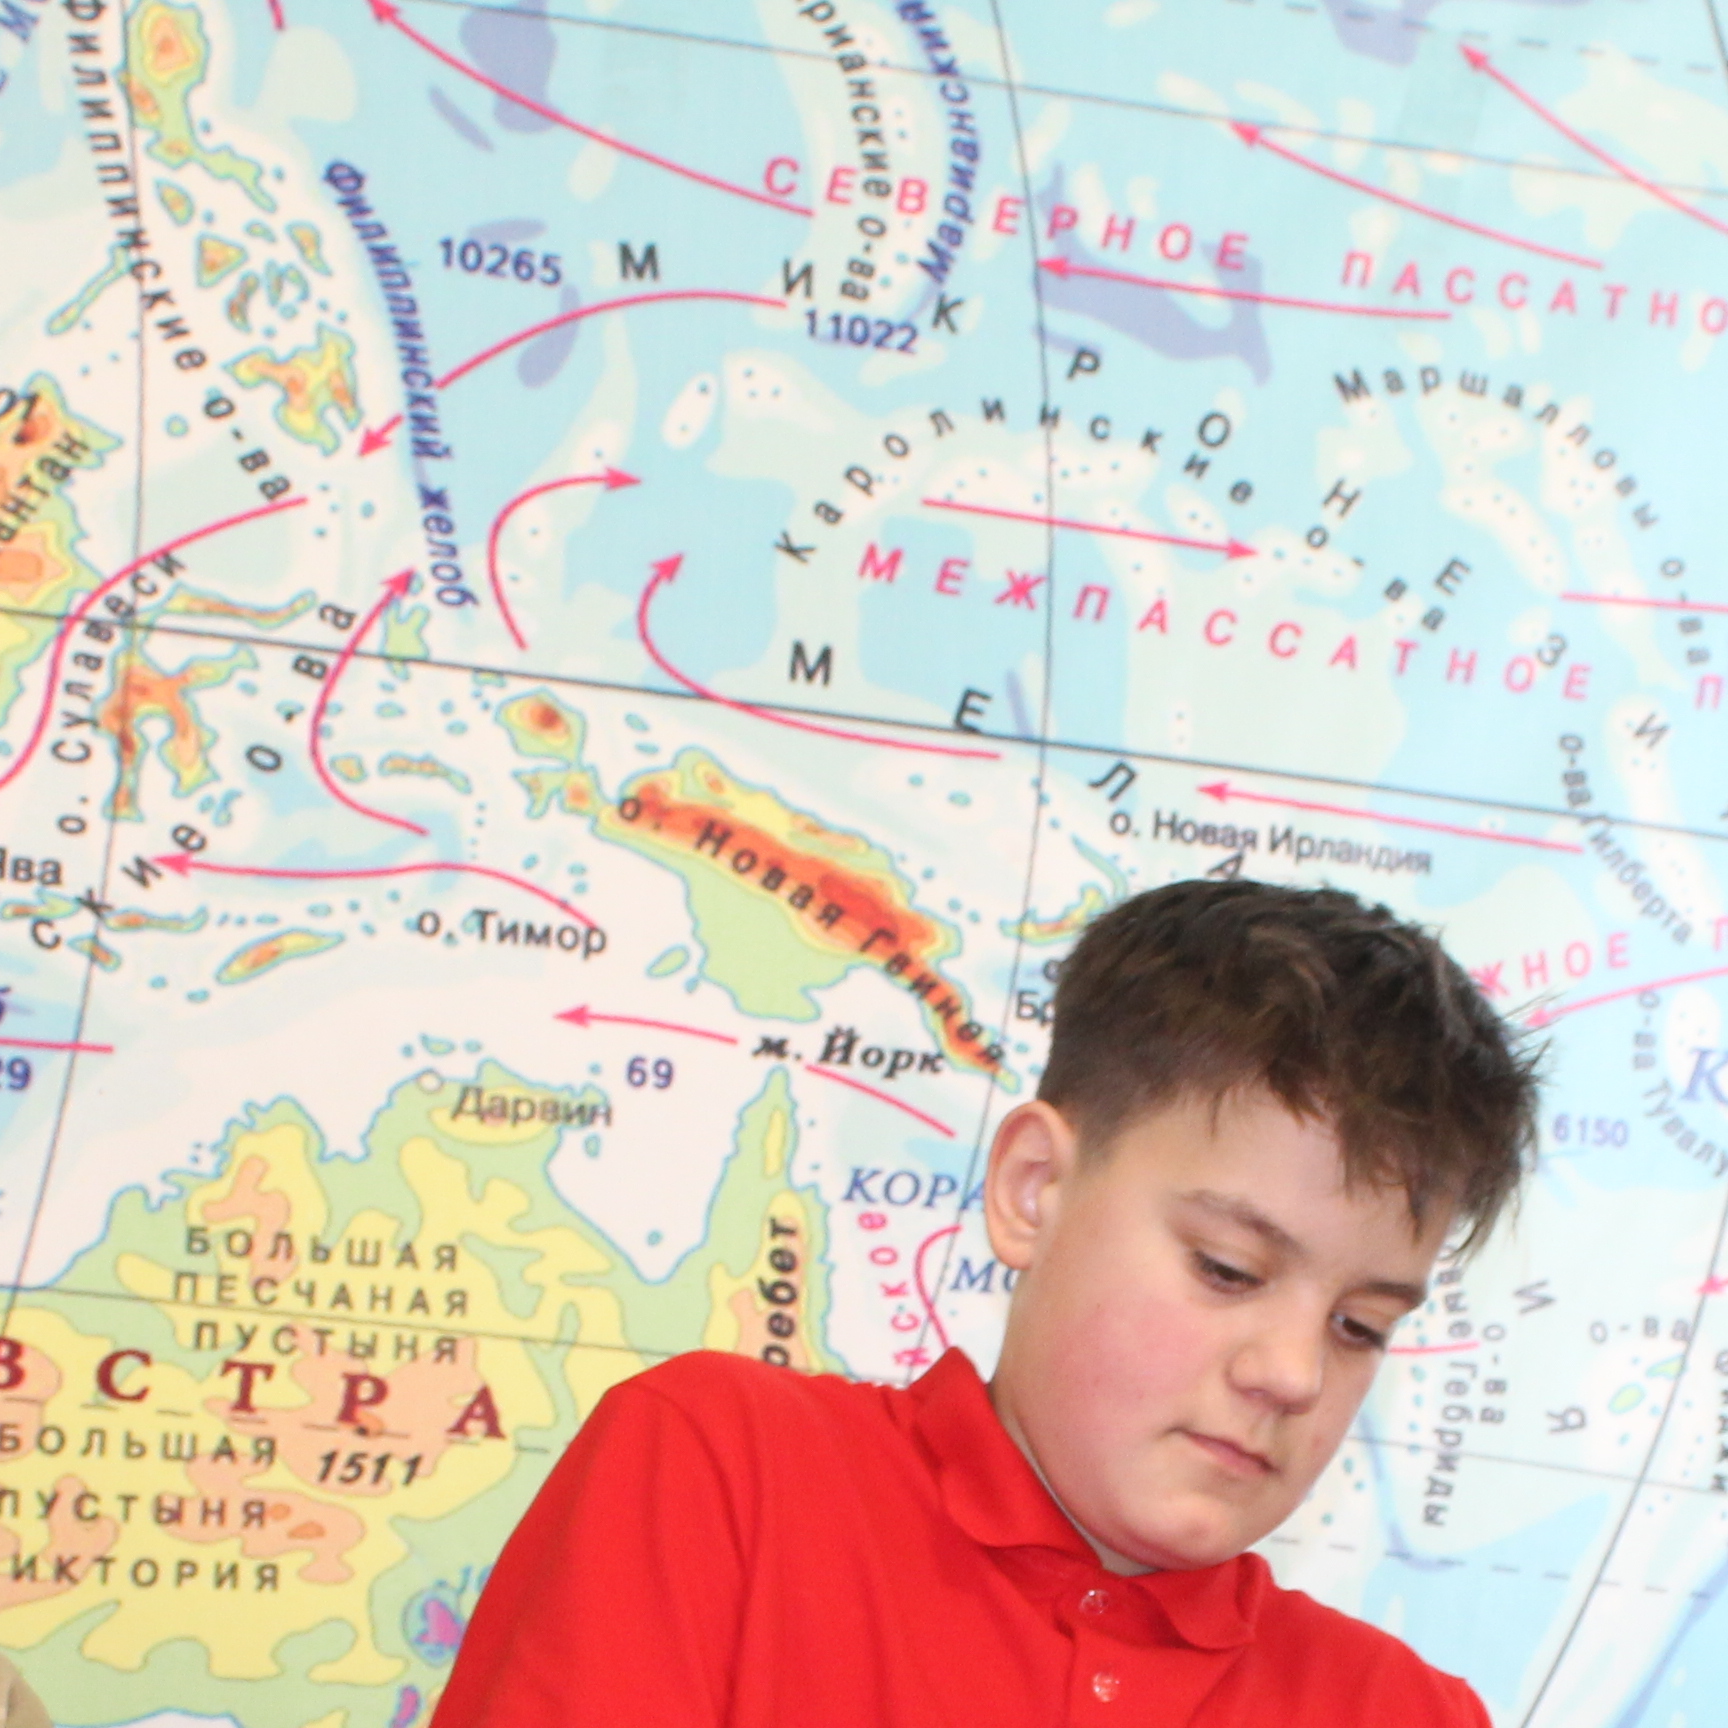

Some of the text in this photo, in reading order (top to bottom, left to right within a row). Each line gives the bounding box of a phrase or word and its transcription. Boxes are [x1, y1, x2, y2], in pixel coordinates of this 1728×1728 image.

[796, 0, 893, 199] рианские
[763, 157, 1252, 272] СЕВЕРНОЕ
[440, 237, 563, 288] 10265
[803, 307, 920, 353] 11022
[322, 160, 478, 610] Филиппинский желоб
[202, 392, 294, 504] о-ва
[1334, 368, 1660, 532] Маршалловы
[858, 543, 1594, 700] МЕЖПАССАТНОЕ
[50, 552, 186, 765] Сулавеси
[1153, 810, 1258, 853] Новая
[1269, 826, 1433, 878] Ирландия
[472, 909, 608, 962] Тимор
[694, 819, 843, 934] Новая
[859, 921, 1007, 1071] Гвинея
[1469, 931, 1630, 1000] ЖНОЕ
[625, 1055, 674, 1090] 69
[819, 1025, 948, 1085] Йорк
[450, 1086, 613, 1129] Дарвин
[1553, 1114, 1630, 1150] 6150
[184, 1225, 460, 1274] БОЛЬШАЯ
[171, 1272, 470, 1317] ПЕСЧАНАЯ
[756, 1216, 799, 1367] ребет
[193, 1320, 461, 1365] ПУСТЫНЯ
[314, 1446, 426, 1489] 1511
